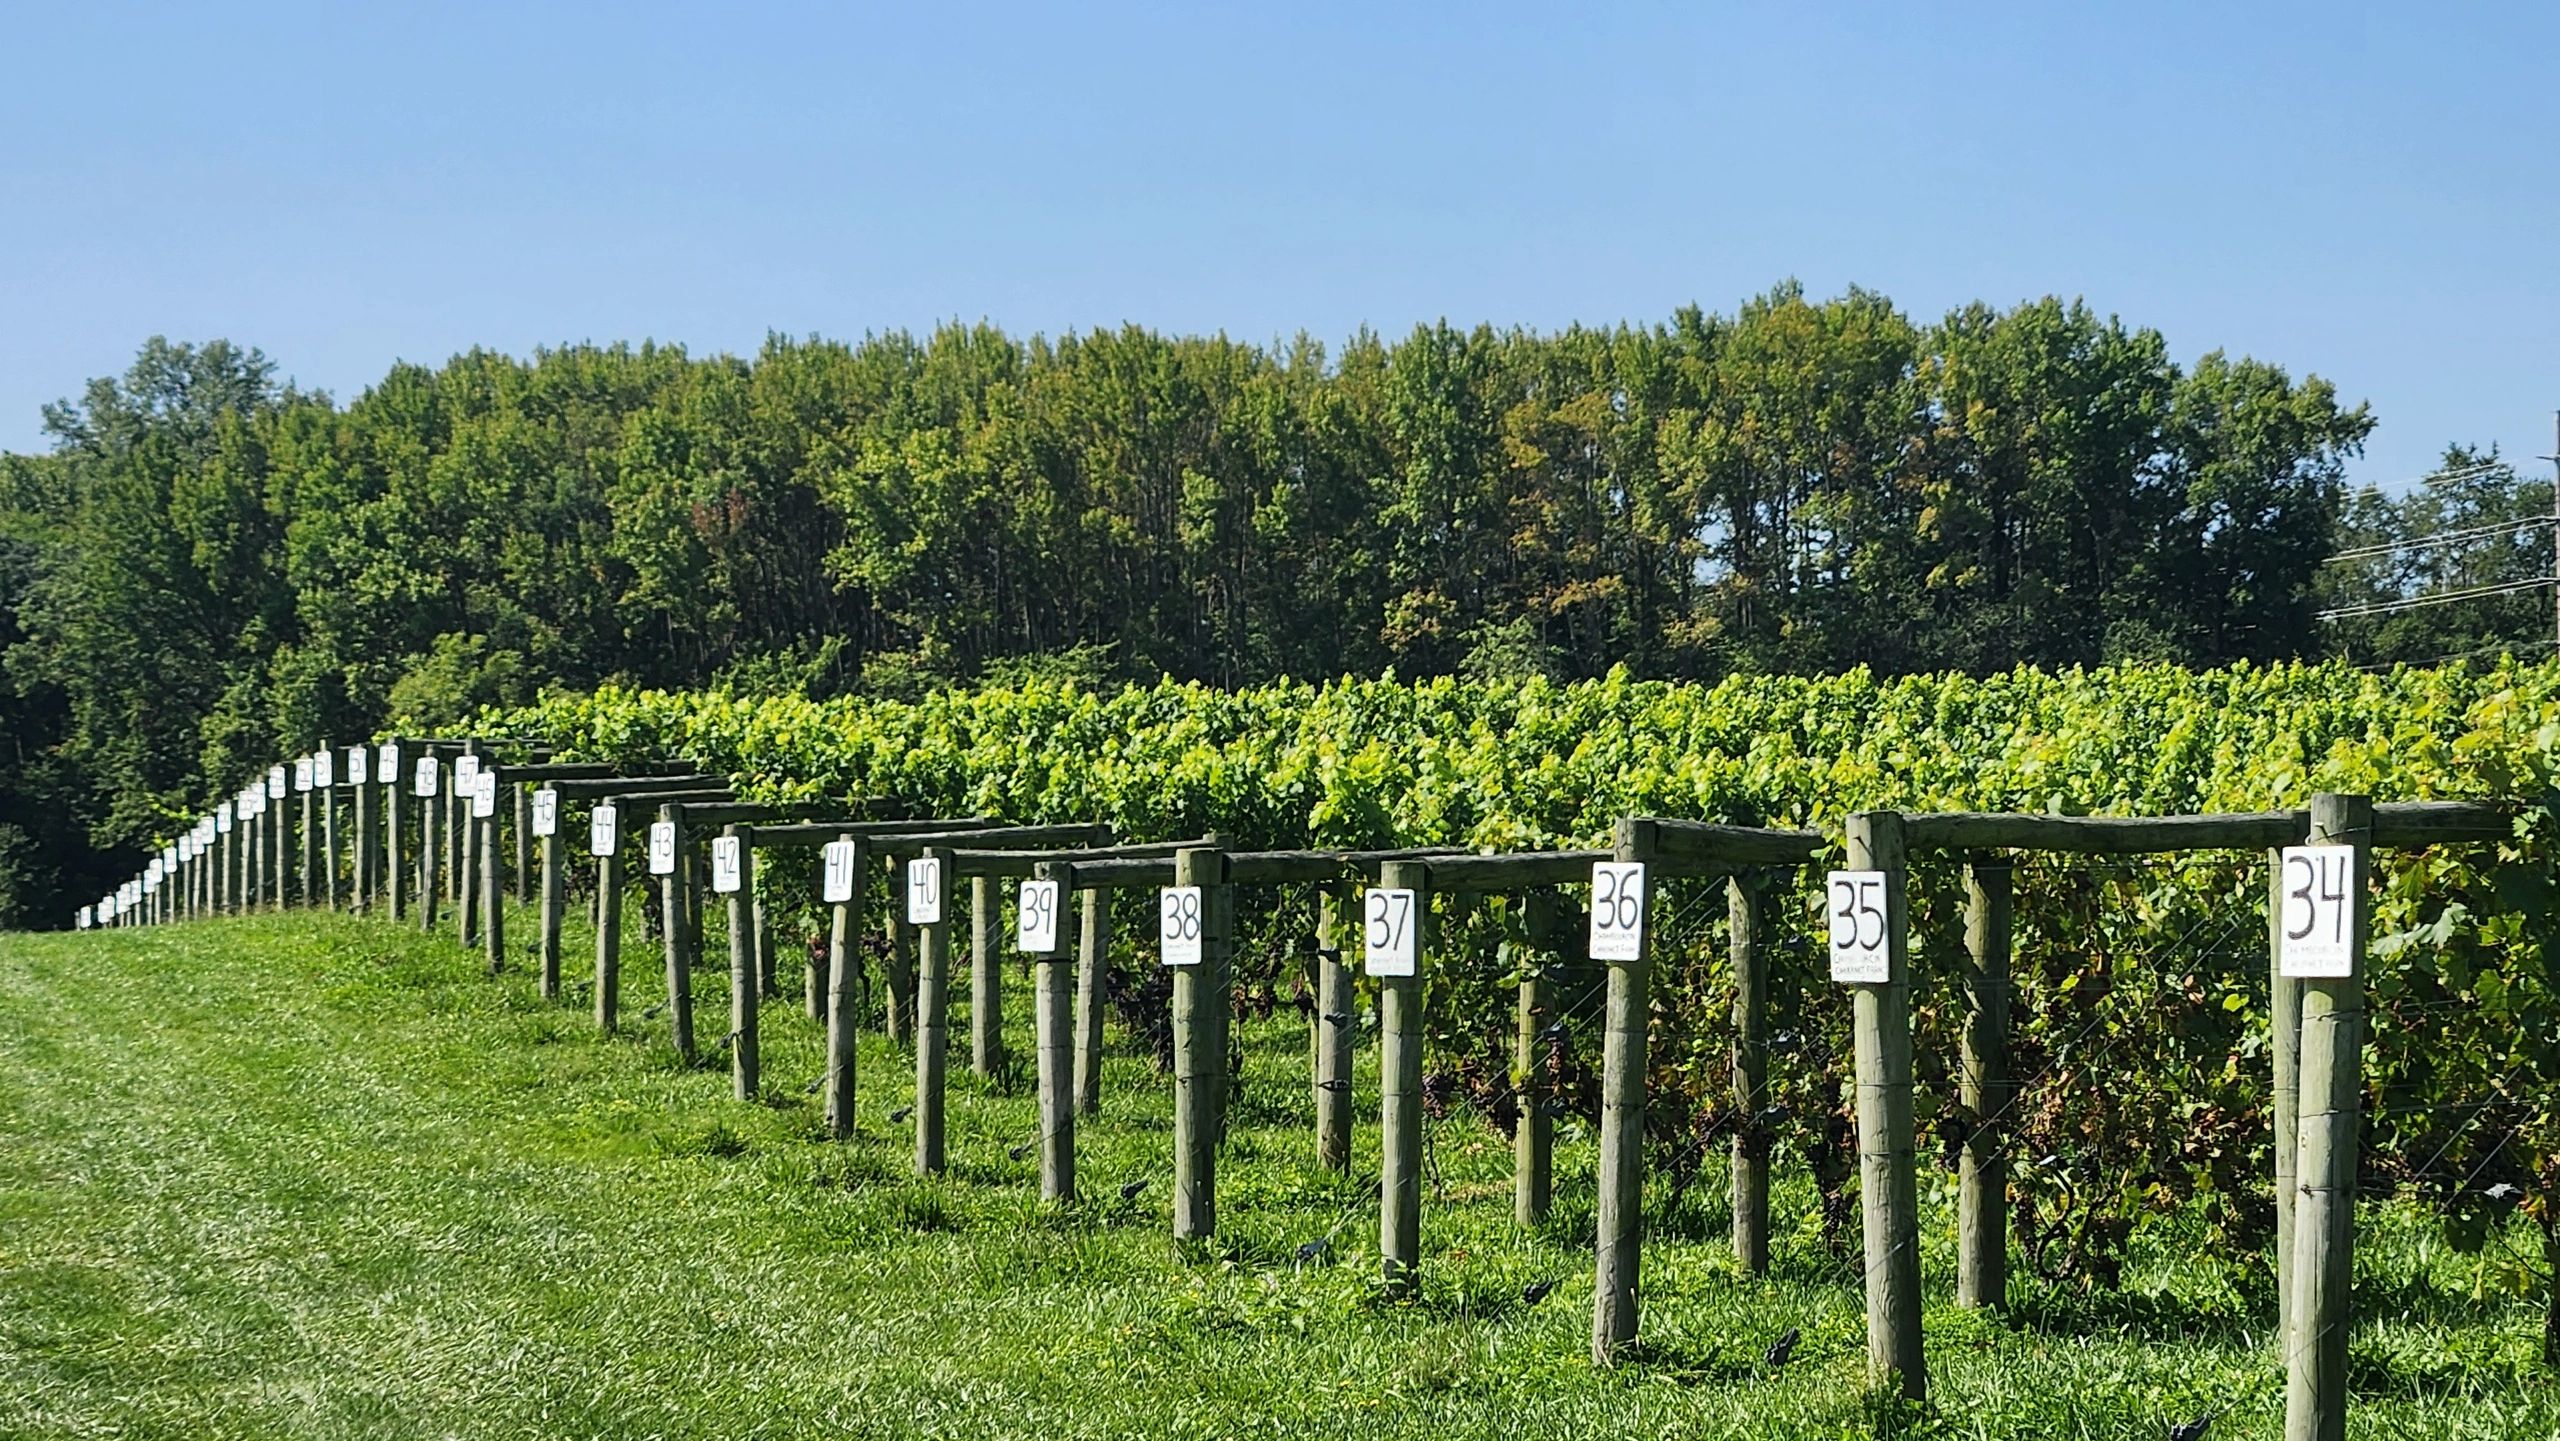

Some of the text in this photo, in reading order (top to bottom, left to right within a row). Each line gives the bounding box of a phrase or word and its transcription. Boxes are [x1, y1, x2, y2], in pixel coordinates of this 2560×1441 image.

[537, 793, 554, 822] 45
[654, 826, 672, 857] 43
[717, 840, 737, 874] 42
[830, 846, 848, 884] 41
[912, 862, 938, 904] 40
[1597, 869, 1639, 930] 36
[2288, 855, 2345, 943] 34
[1023, 887, 1052, 934] 39
[1165, 893, 1200, 941] 38
[1371, 893, 1410, 951] 37
[1835, 881, 1884, 951] 35
